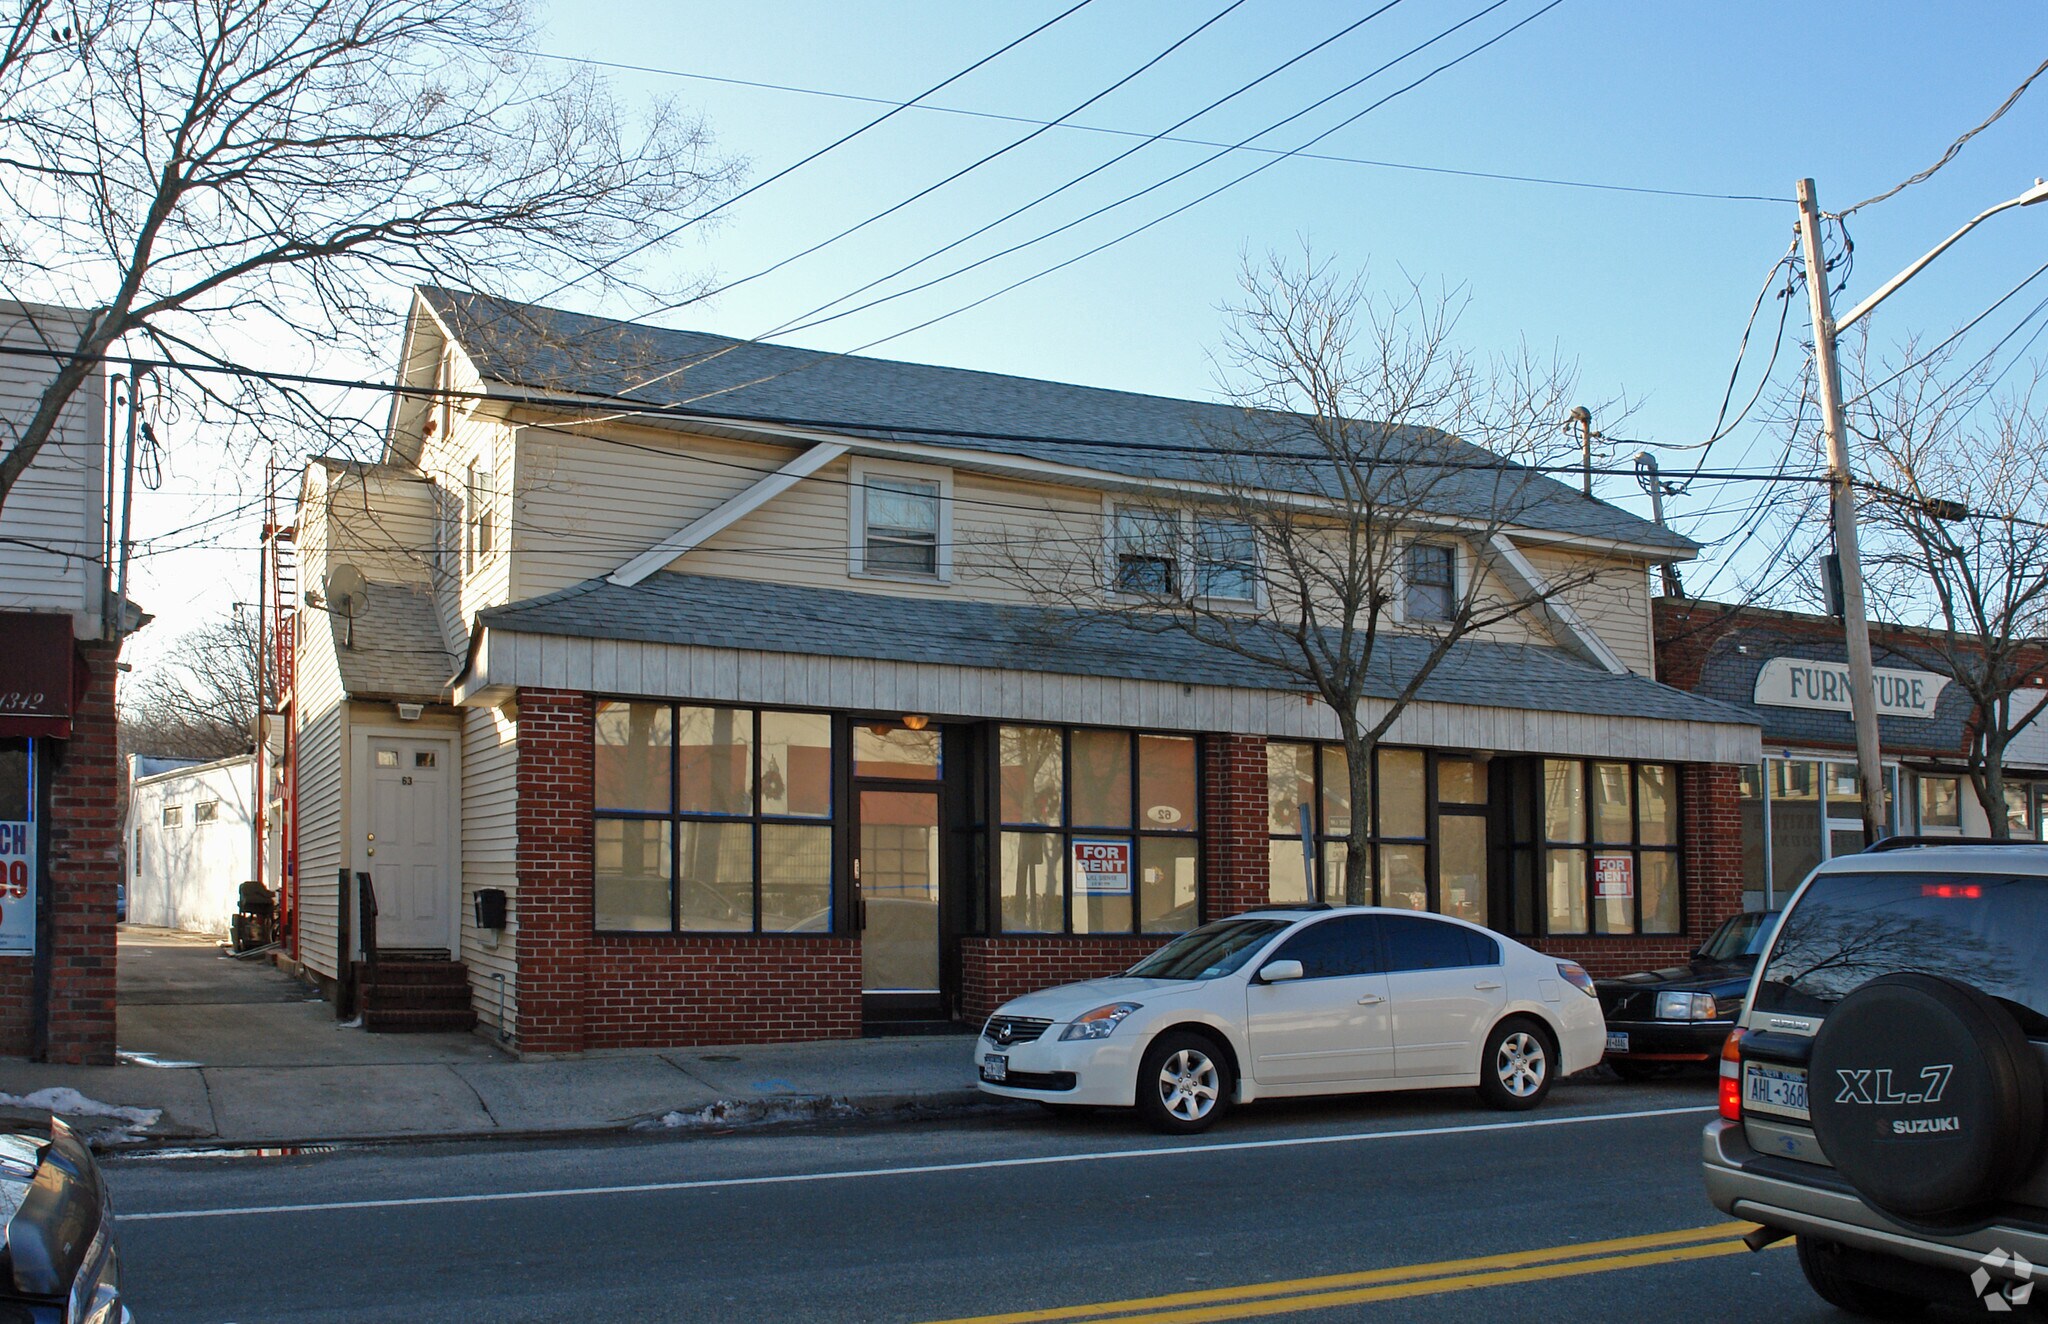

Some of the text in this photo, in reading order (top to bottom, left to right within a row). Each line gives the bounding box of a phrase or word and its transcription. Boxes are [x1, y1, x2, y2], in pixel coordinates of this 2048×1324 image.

[1789, 667, 1926, 710] FURNTURE
[402, 776, 413, 786] 63
[1083, 846, 1119, 859] FOR
[1078, 859, 1125, 872] RENT
[1599, 860, 1625, 870] FOR
[1595, 871, 1629, 882] RENT
[1892, 1116, 1960, 1134] SUZUKI
